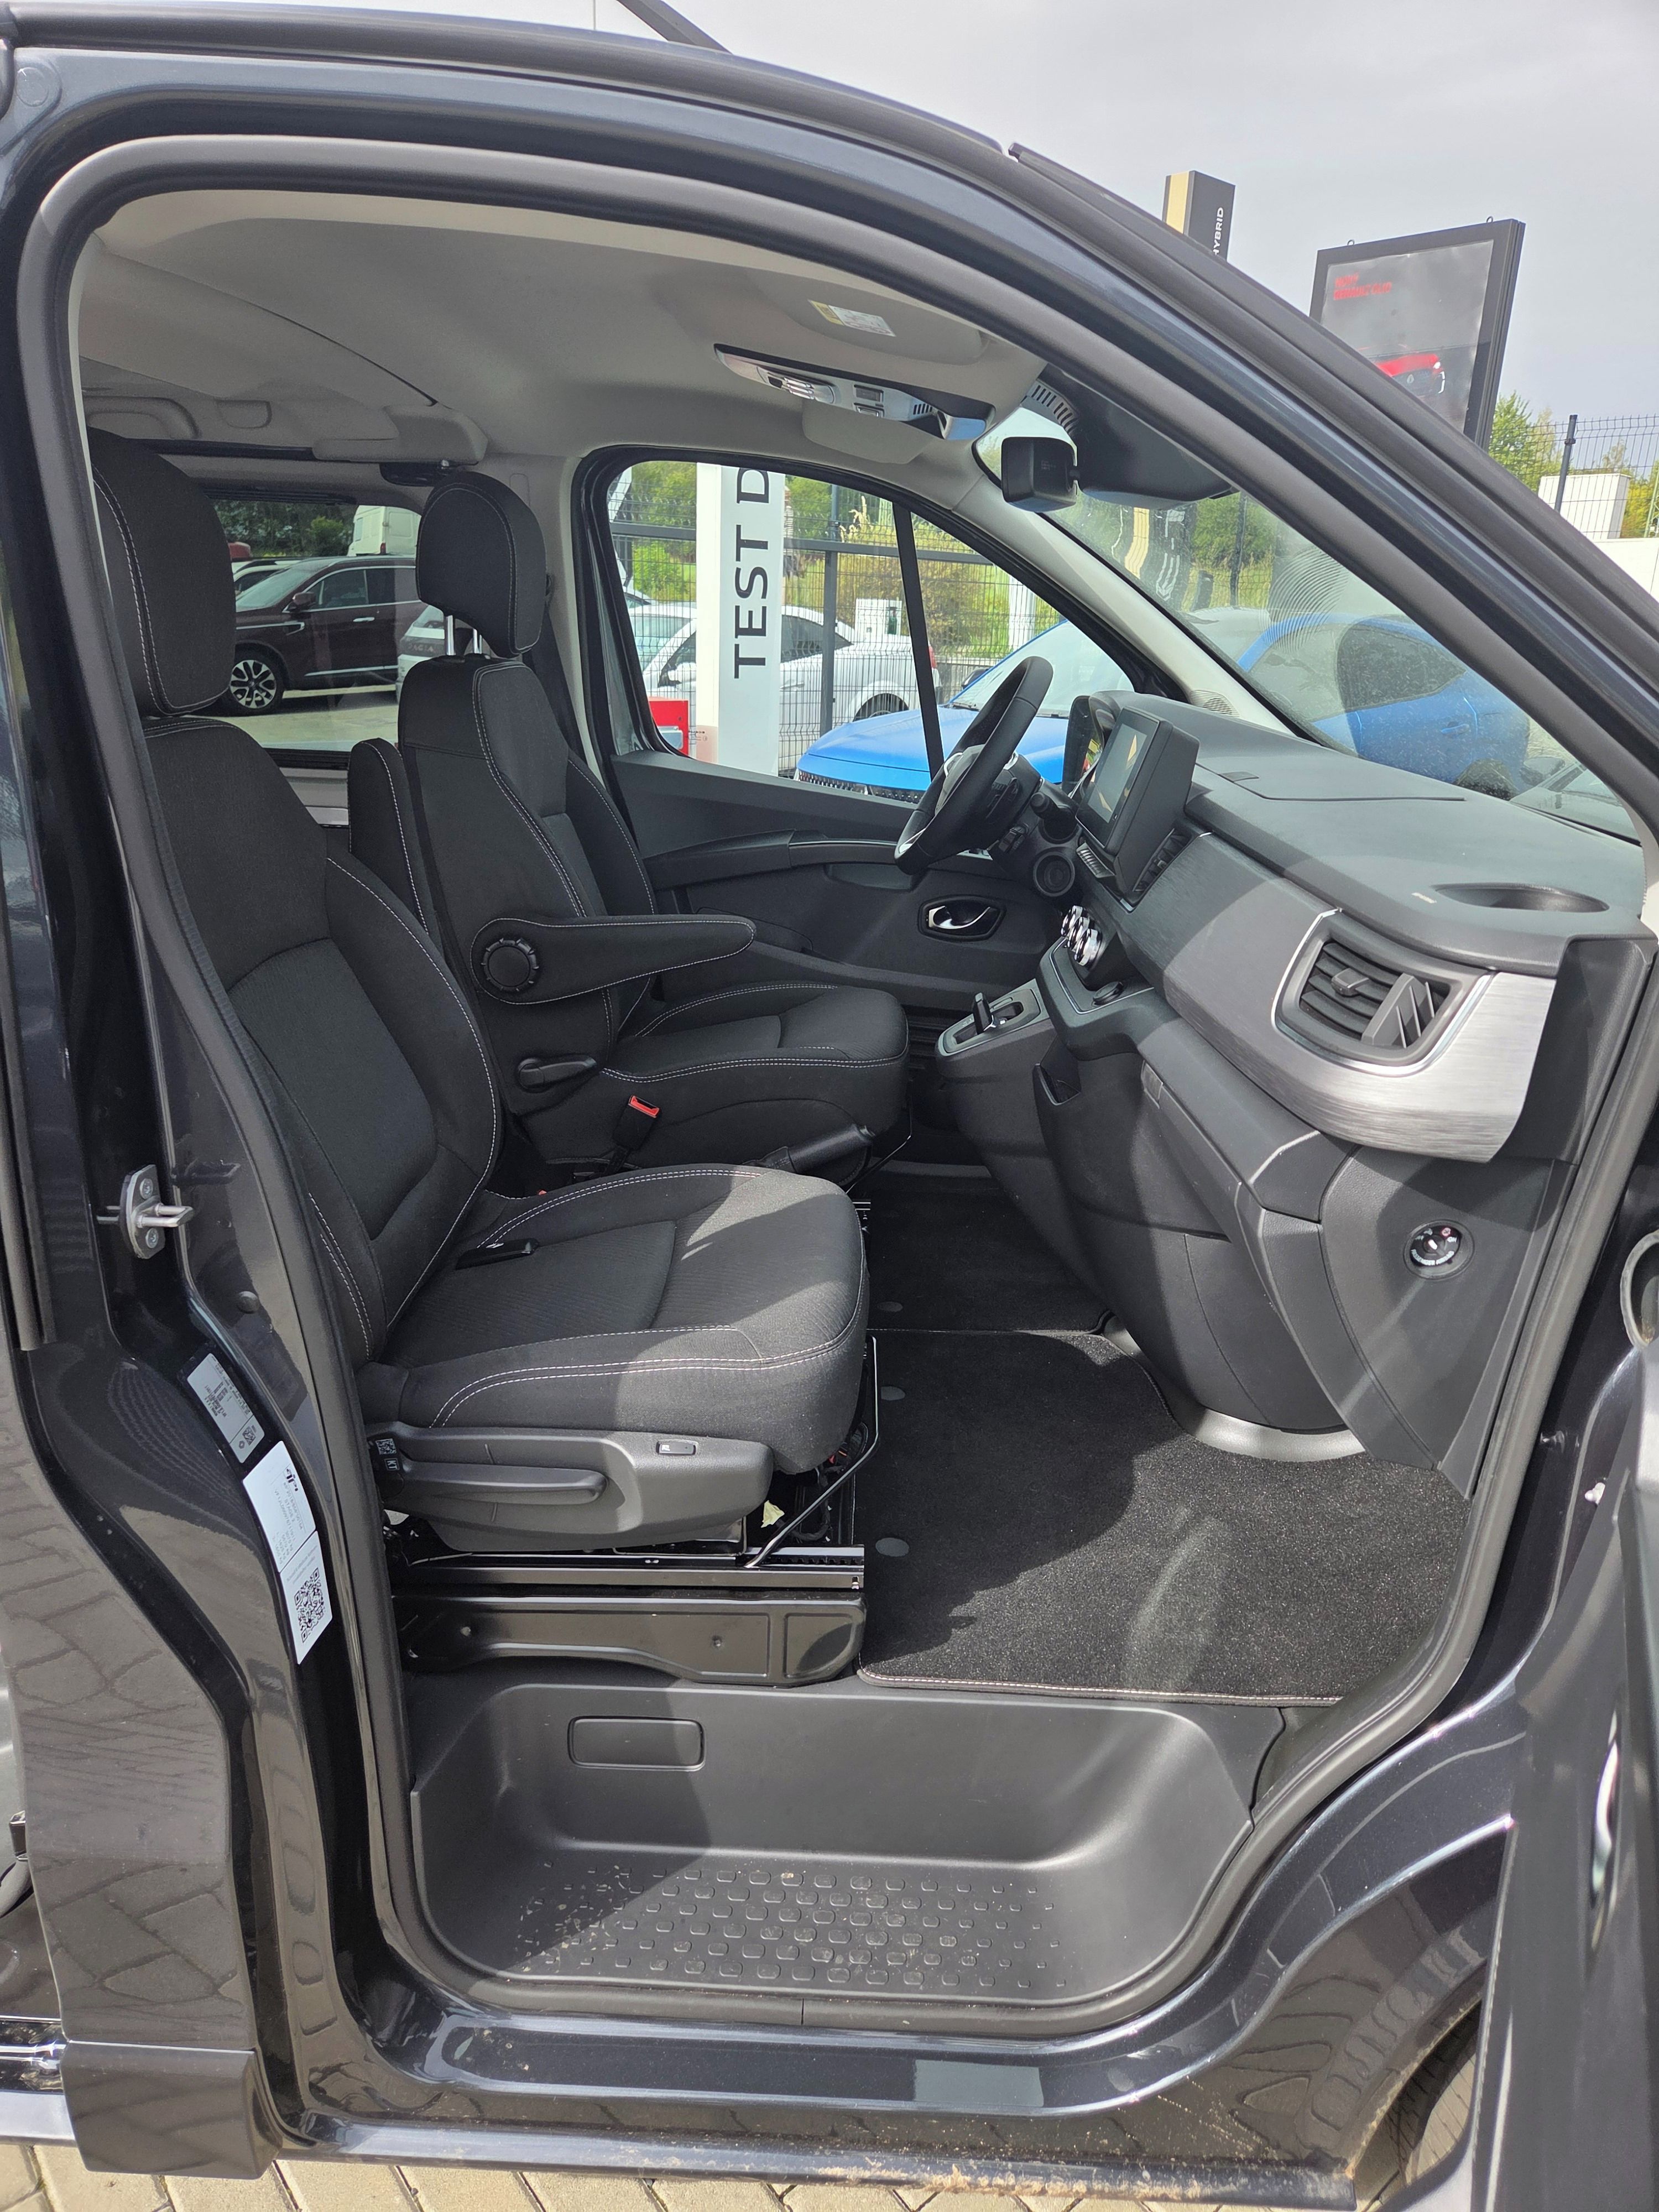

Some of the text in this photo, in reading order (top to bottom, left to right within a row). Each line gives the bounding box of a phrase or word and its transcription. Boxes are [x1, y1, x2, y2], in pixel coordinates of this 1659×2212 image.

[1334, 284, 1371, 300] RENAULT
[734, 524, 769, 679] TEST
[387, 1460, 398, 1470] KT
